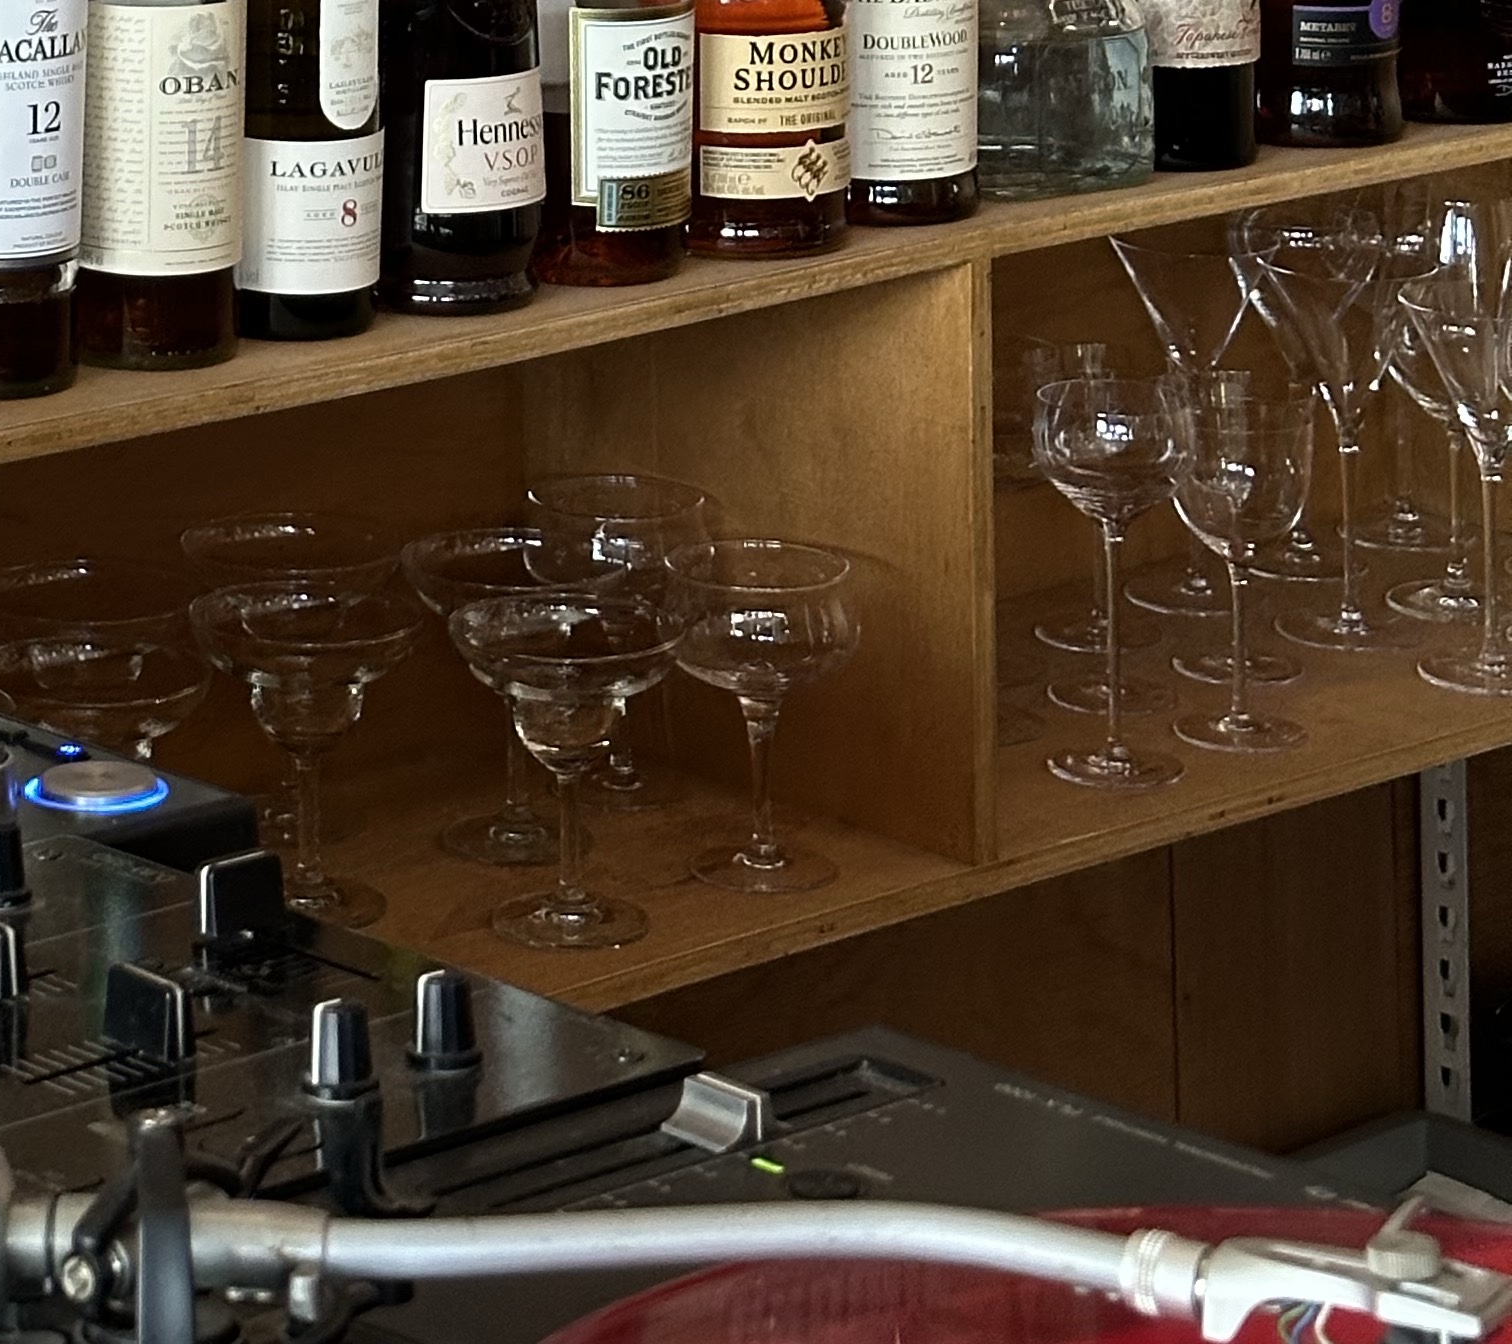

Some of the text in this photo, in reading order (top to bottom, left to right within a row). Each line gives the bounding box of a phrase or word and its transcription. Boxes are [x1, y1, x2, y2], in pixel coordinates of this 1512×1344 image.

[25, 9, 59, 36] The
[643, 46, 682, 72] OLD
[41, 66, 71, 79] SINGLE
[159, 69, 241, 96] OBAN
[911, 64, 934, 84] 12
[5, 81, 45, 92] SCOTCH
[733, 96, 782, 105] BLENDED
[26, 100, 62, 136] 12
[780, 111, 836, 126] THE ORIGINAL
[181, 115, 225, 174] 14
[10, 176, 50, 189] DOUBLE
[621, 183, 650, 201] 86
[341, 199, 357, 227] 8
